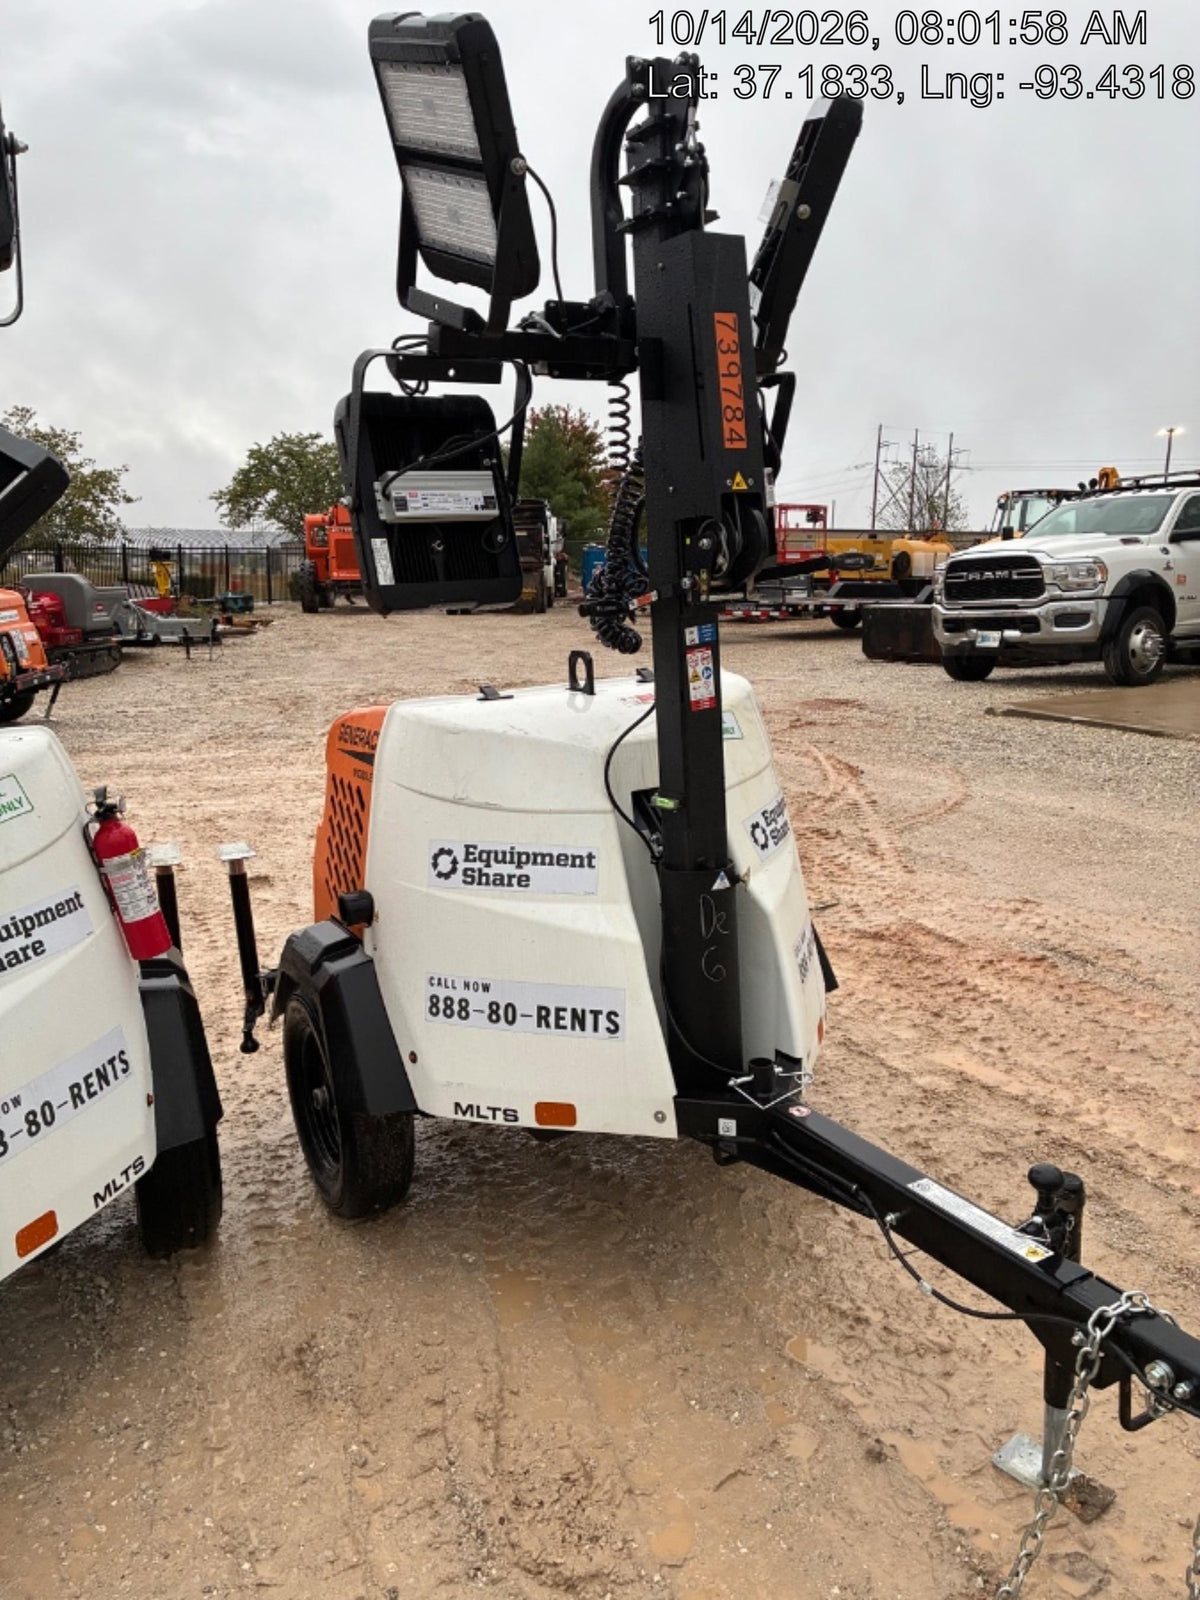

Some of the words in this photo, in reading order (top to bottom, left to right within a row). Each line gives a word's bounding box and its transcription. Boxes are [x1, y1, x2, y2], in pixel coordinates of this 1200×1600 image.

[716, 317, 745, 444] 739784
[968, 570, 1010, 580] RAM
[463, 844, 597, 870] Equipment
[462, 867, 531, 888] Share
[428, 976, 458, 990] CALL
[463, 980, 492, 994] NOW
[428, 993, 620, 1036] 888-80-RENTS
[0, 1094, 22, 1118] OW
[454, 1101, 520, 1123] MLTS
[92, 1155, 146, 1209] MLTS
